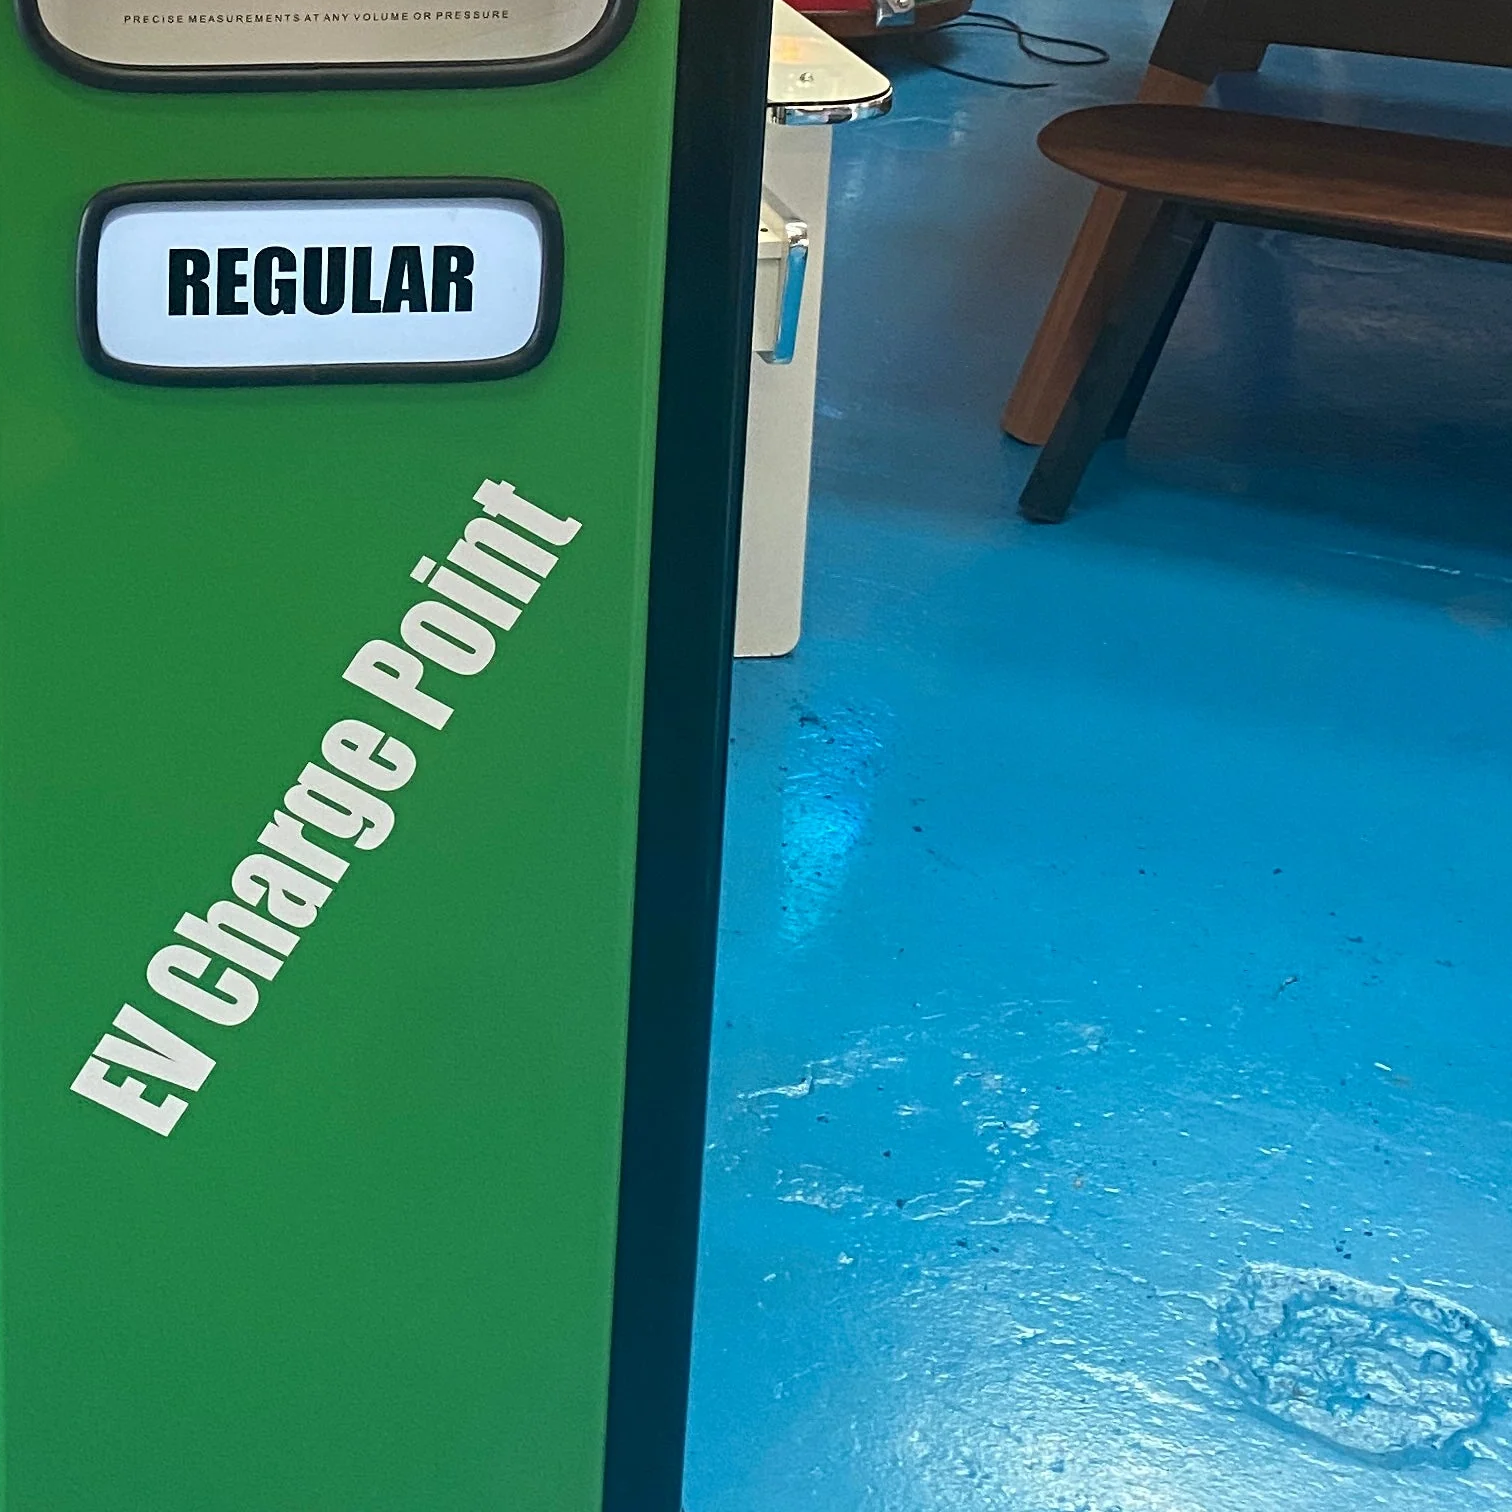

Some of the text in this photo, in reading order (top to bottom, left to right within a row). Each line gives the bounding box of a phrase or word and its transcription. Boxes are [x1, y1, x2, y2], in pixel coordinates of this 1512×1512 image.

[124, 9, 510, 24] PRECISE MEASUREMENTS AT ANY VOLUME OR PRESSURE
[168, 245, 475, 317] REGULAR
[70, 477, 584, 1138] EV Charge Point
